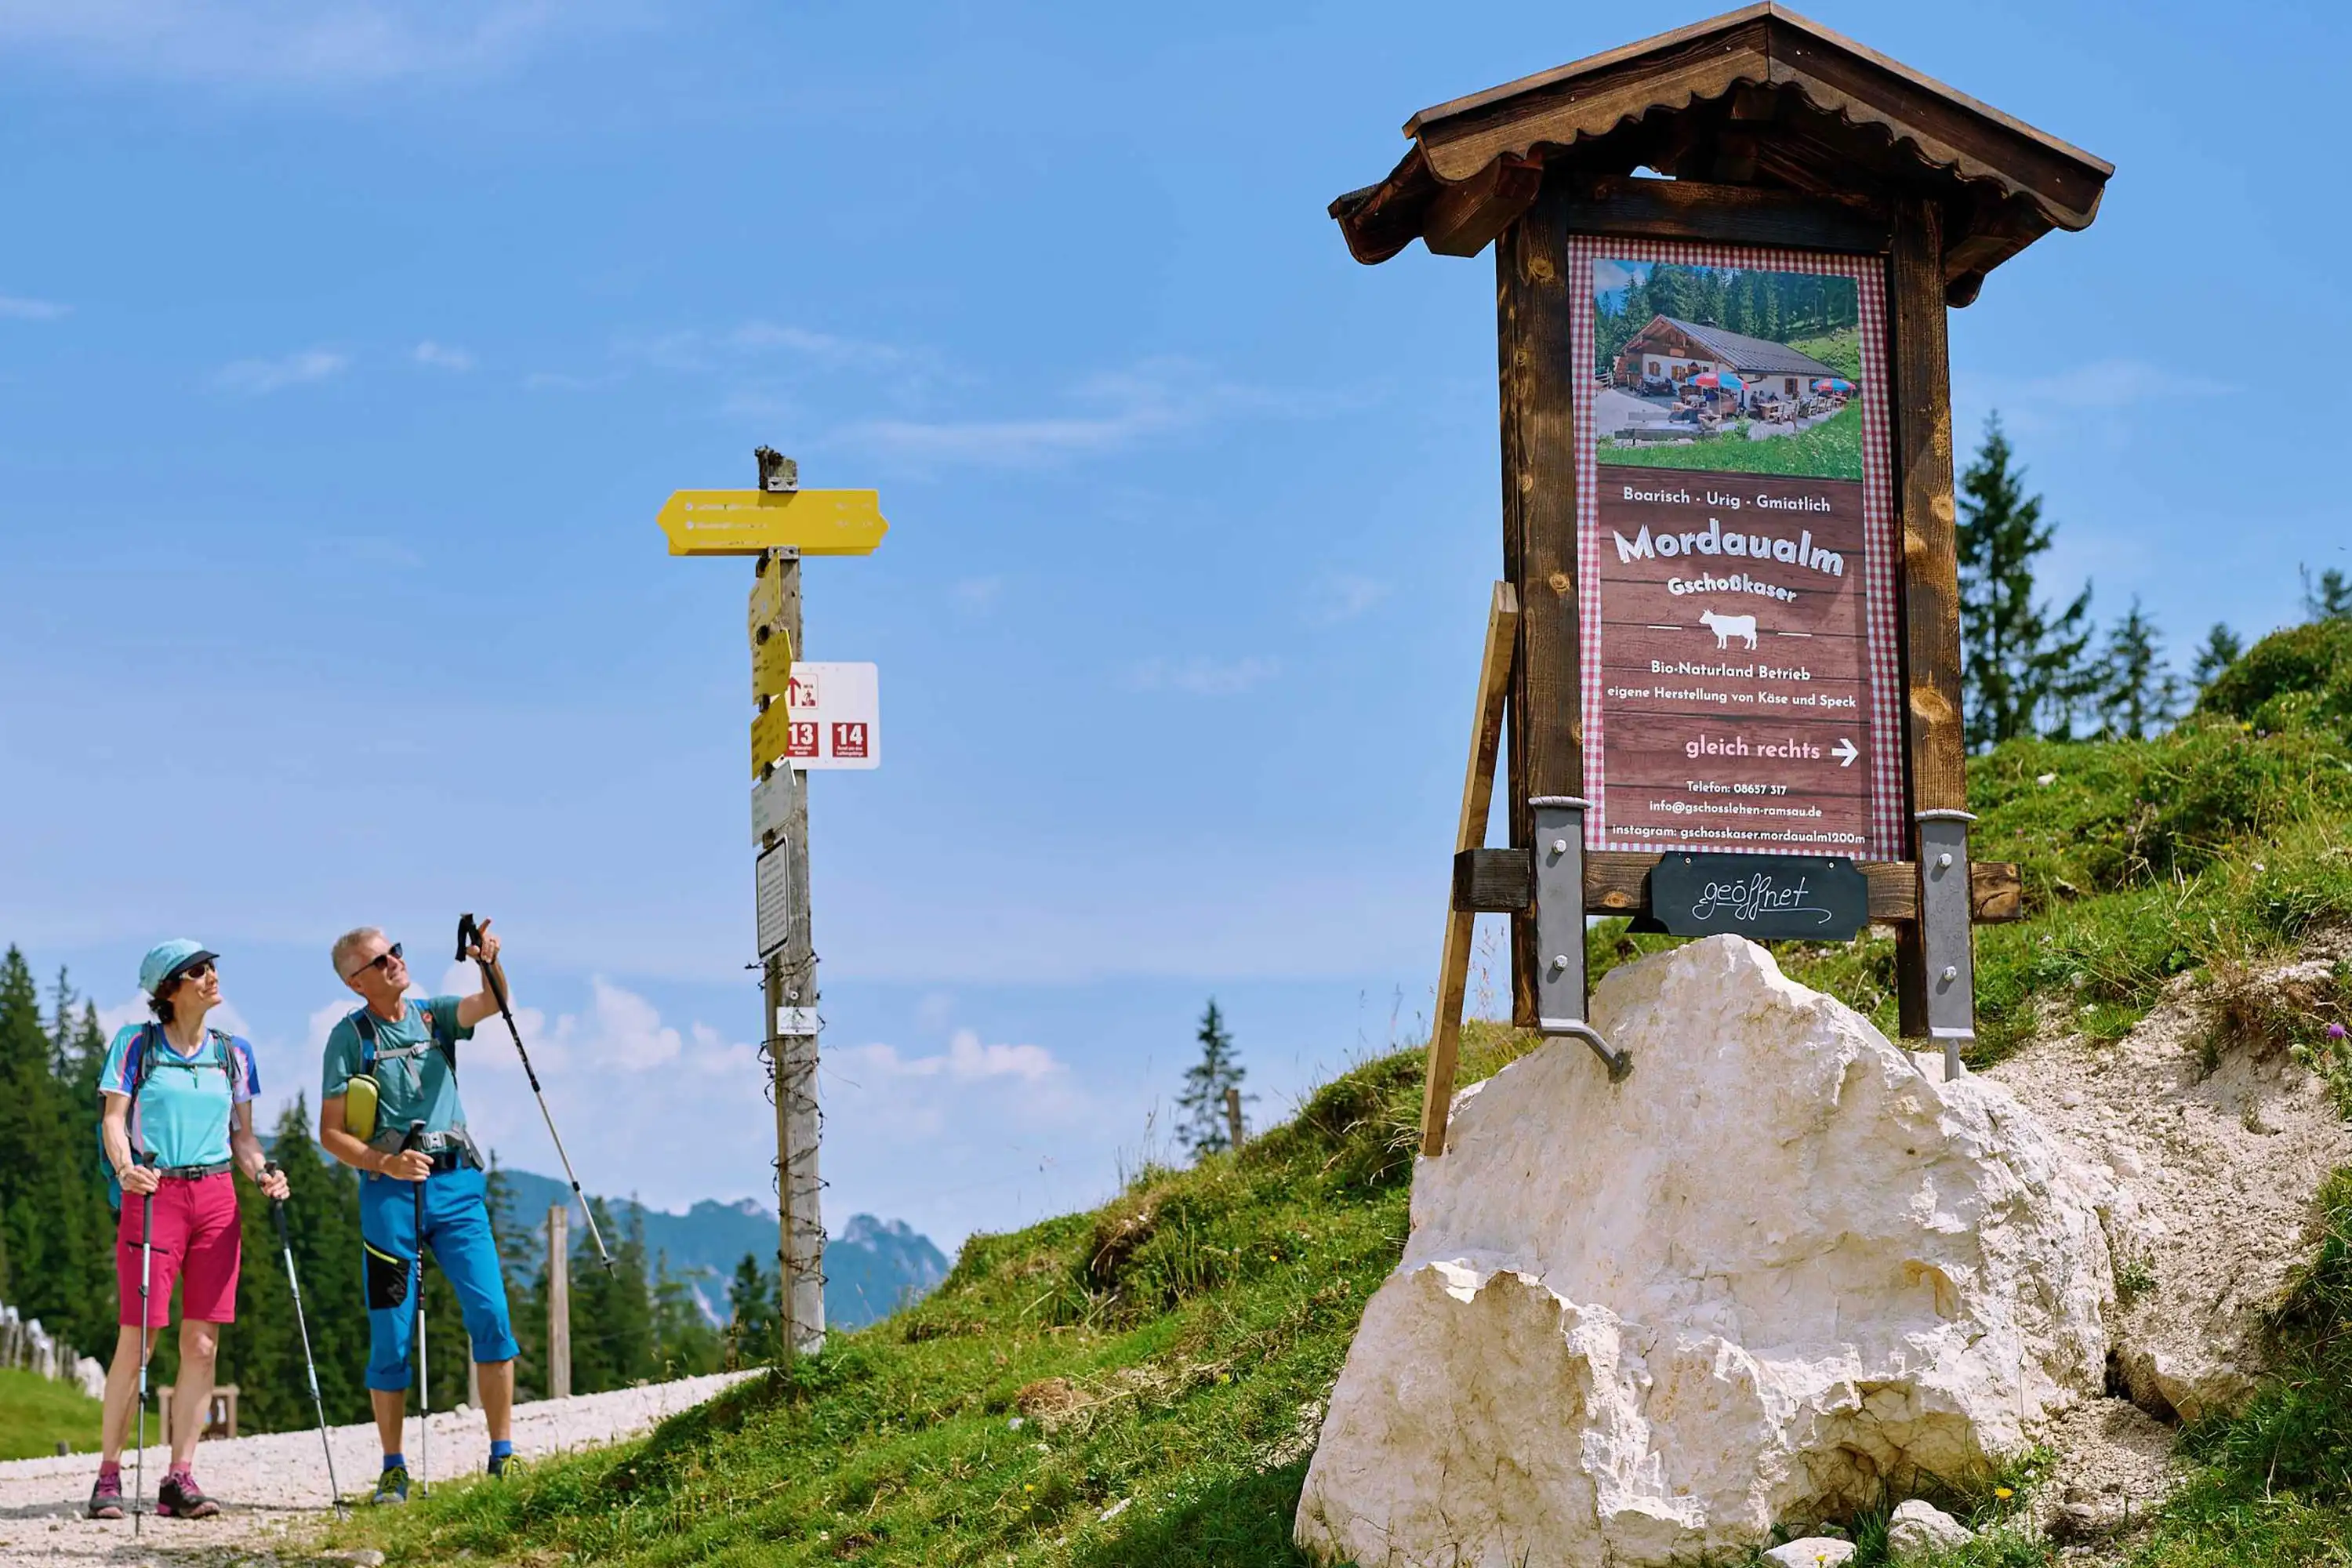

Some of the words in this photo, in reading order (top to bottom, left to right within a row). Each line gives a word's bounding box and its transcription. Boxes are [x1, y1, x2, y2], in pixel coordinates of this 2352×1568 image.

[1623, 486, 1690, 504] Boarisch
[1706, 491, 1741, 510] Urig
[1756, 494, 1831, 512] Gmiatlich
[1613, 517, 1845, 577] Mordaualm
[1668, 572, 1798, 604] Gschoßkaser
[1651, 659, 1753, 678] Bio-Naturland
[1759, 664, 1811, 681] Betrieb
[1607, 685, 1650, 699] eigene
[1654, 686, 1727, 704] Herstellung
[1731, 694, 1754, 703] von
[1758, 691, 1788, 705] Käse
[1792, 693, 1816, 706] und
[1820, 695, 1857, 709] Speck
[788, 723, 814, 746] 13
[837, 724, 863, 746] 14
[1686, 734, 1749, 759] gleich
[1757, 738, 1820, 760] rechts
[1686, 780, 1731, 793] Telefon:
[1733, 783, 1767, 795] 08657
[1770, 785, 1788, 796] 317
[1650, 800, 1823, 818] info@gschosslehen-ramsau.de
[1612, 824, 1677, 838] instagram:
[1680, 826, 1866, 844] gschosskaser.mordaualm1200m
